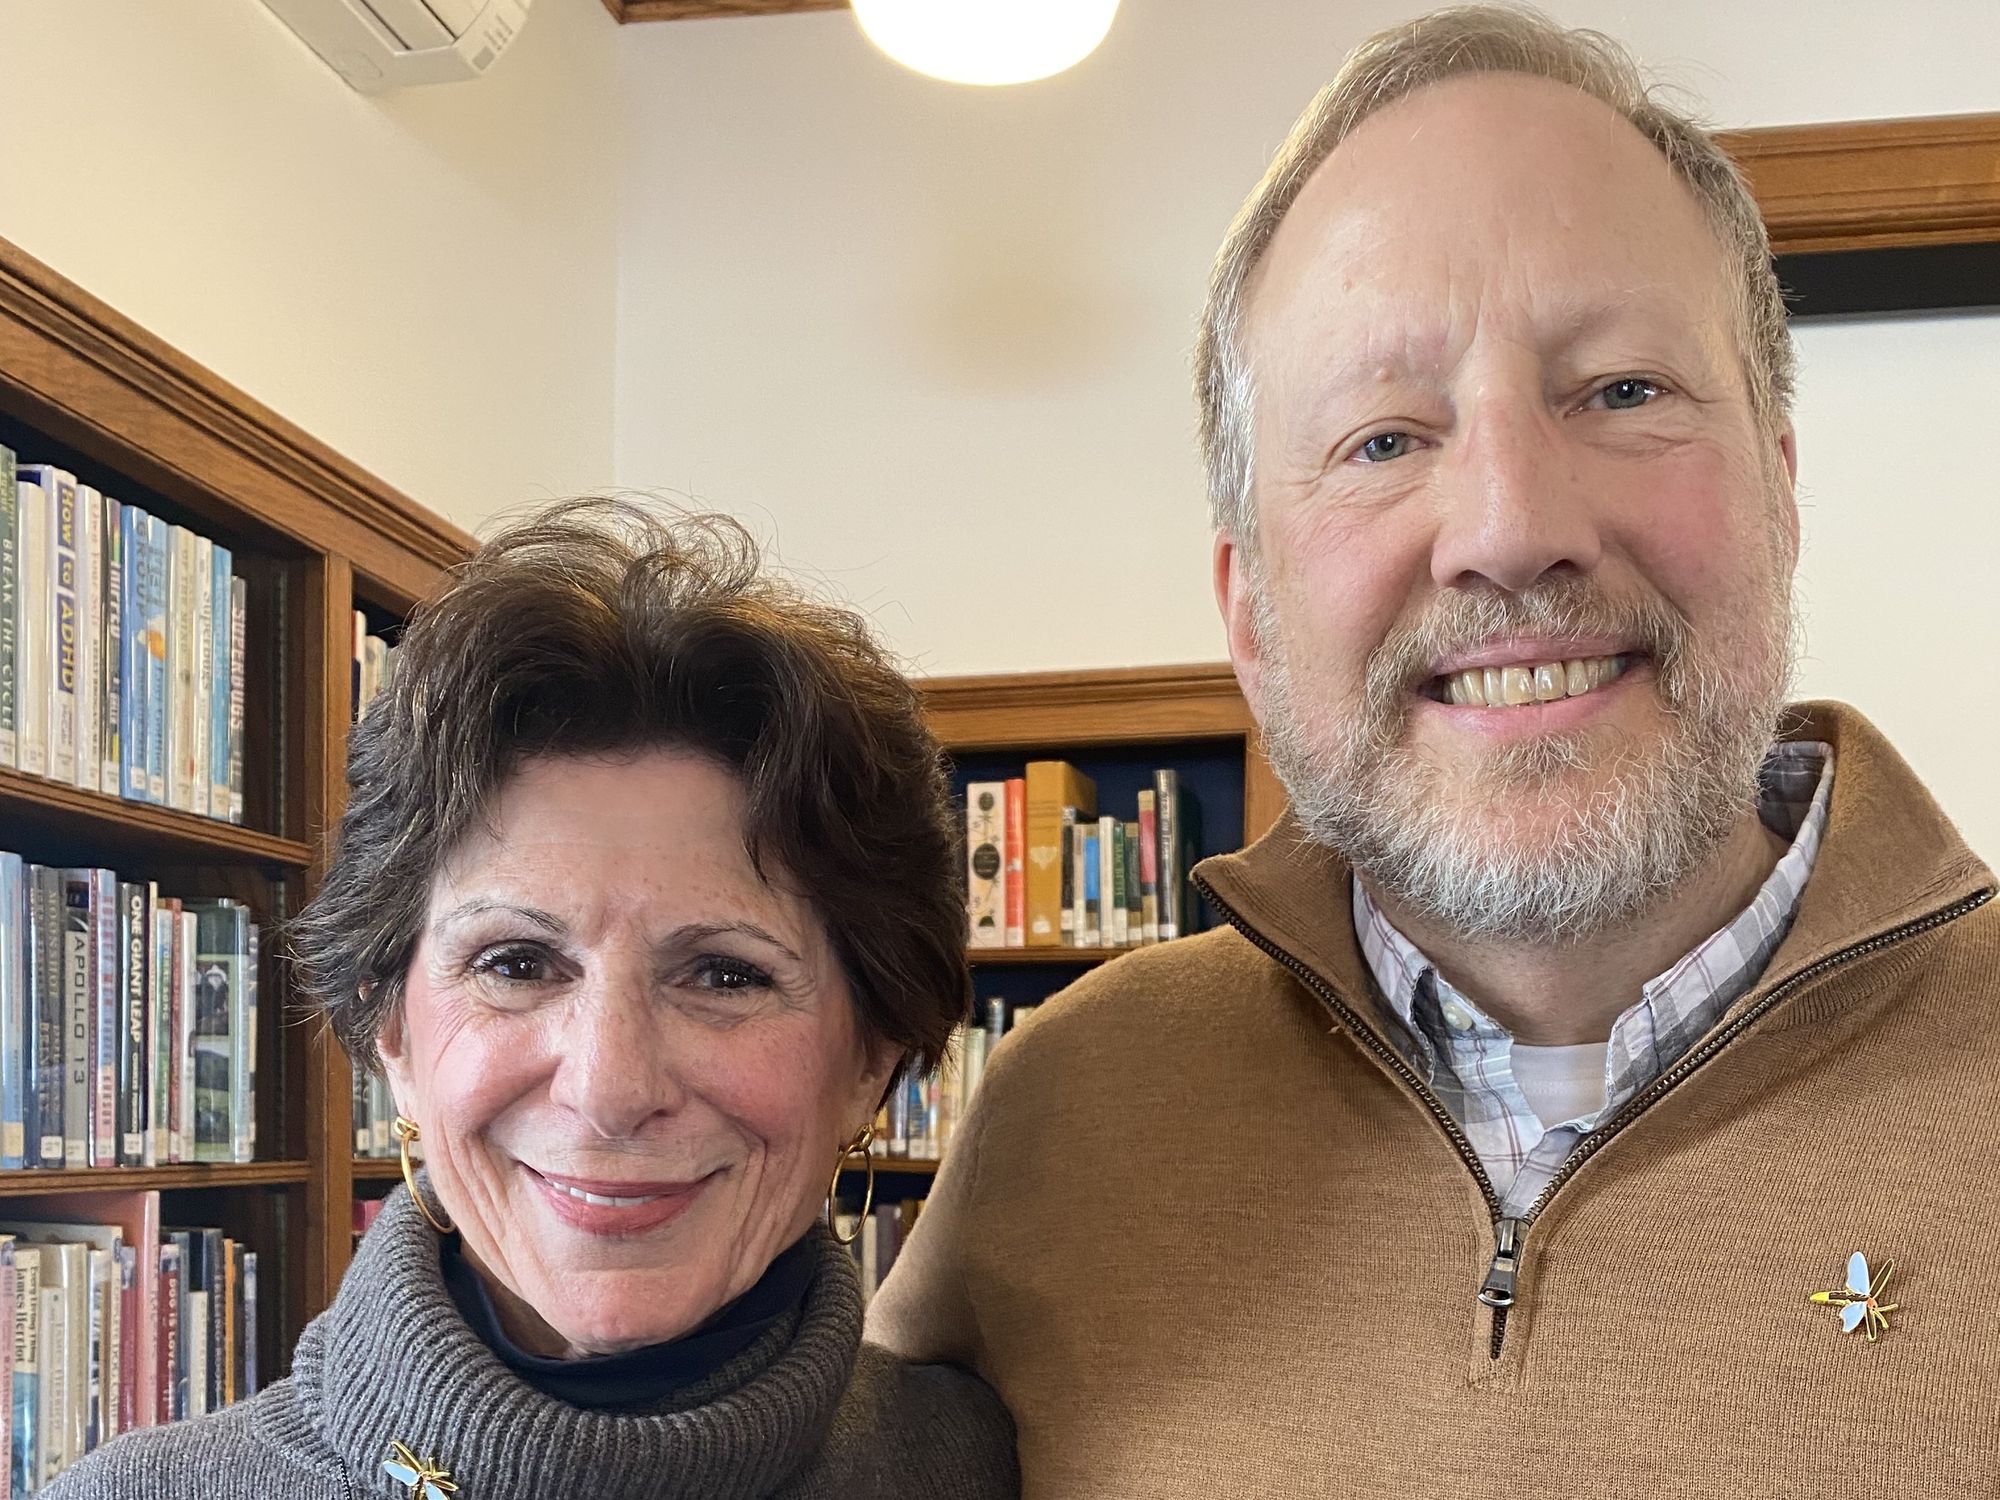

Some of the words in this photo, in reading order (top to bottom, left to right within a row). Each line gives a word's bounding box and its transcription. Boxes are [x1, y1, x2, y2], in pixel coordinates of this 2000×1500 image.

[61, 487, 74, 545] How
[2, 538, 13, 605] BREAK
[61, 561, 74, 585] to
[136, 520, 148, 617] GROUP
[2, 617, 13, 656] THE
[61, 600, 74, 690] ADHD
[232, 607, 245, 731] SUPERBUGS
[2, 663, 13, 728] CYCLE
[130, 894, 142, 935] ONE
[74, 935, 85, 1039] APOLLO
[130, 937, 142, 995] GIANT
[130, 998, 142, 1043] LEAP
[74, 1055, 85, 1084] 13
[15, 1267, 28, 1309] James
[167, 1277, 178, 1308] DOG
[15, 1312, 28, 1363] Herriot
[167, 1330, 178, 1369] LOVE
